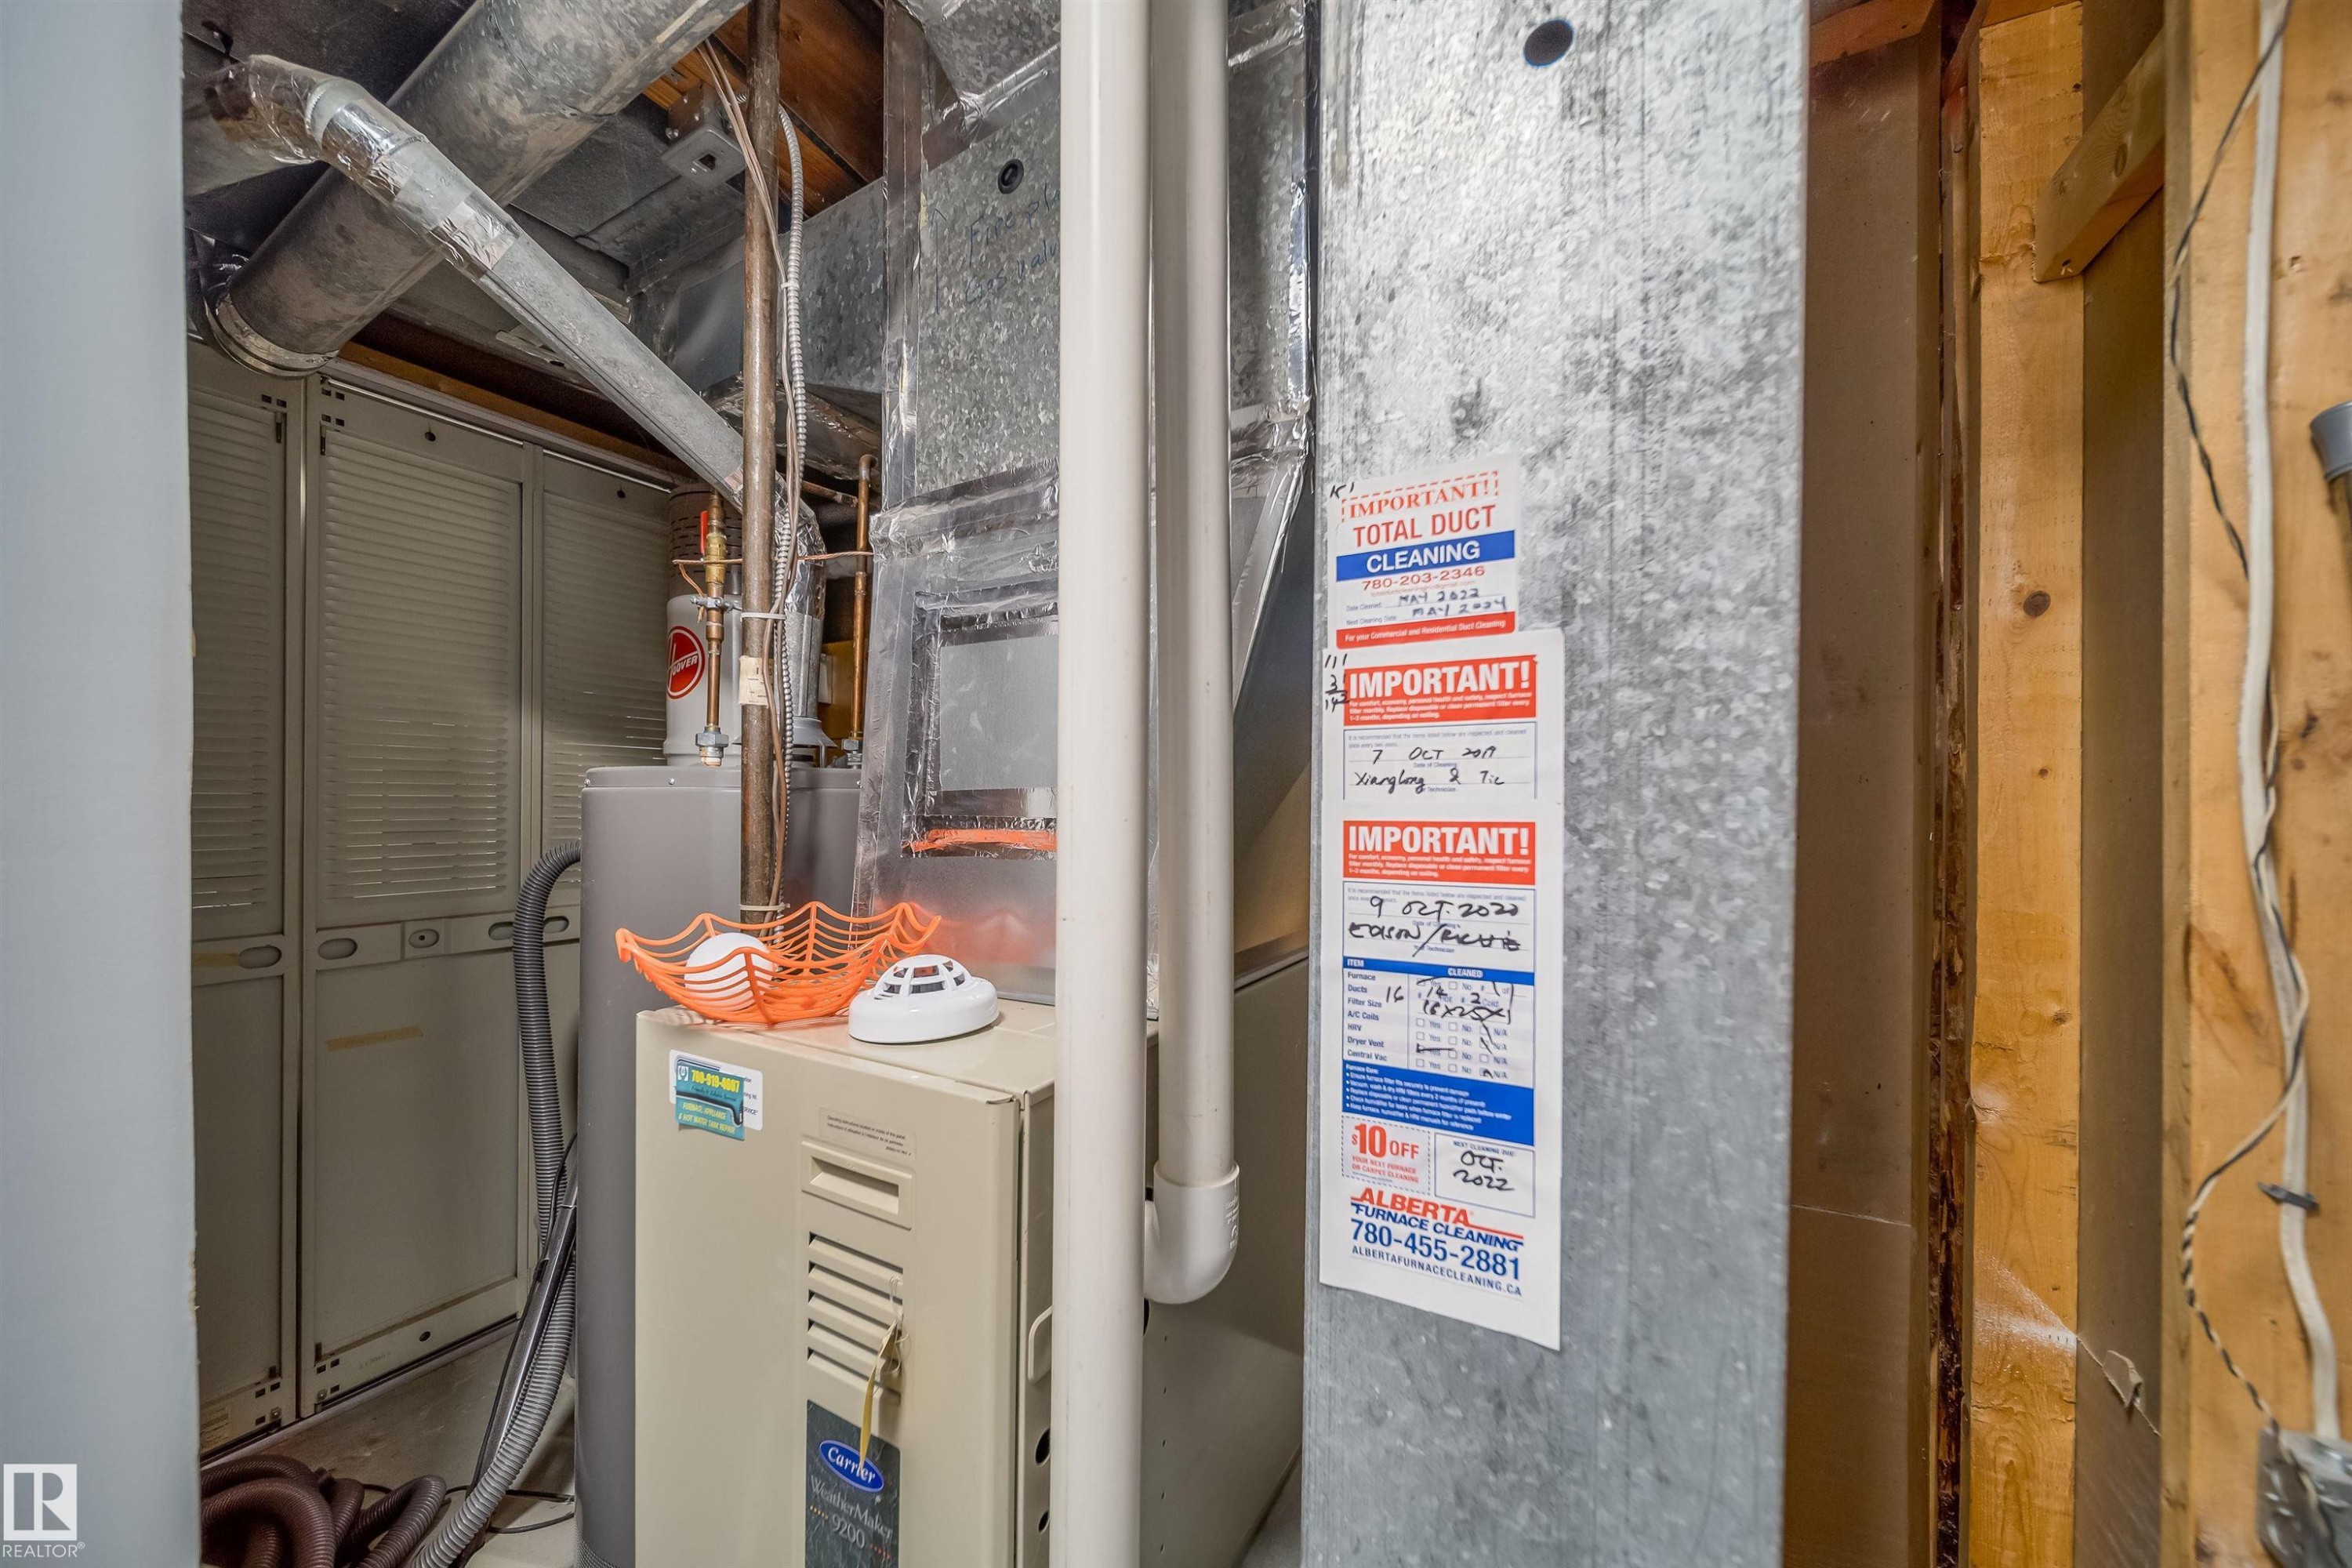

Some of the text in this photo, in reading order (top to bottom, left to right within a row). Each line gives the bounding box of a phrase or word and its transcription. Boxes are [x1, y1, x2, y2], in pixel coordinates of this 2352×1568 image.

[1353, 504, 1496, 548] TOTAL DUCT
[1367, 540, 1480, 573] CLEANING
[1362, 565, 1485, 591] 780-203-2346
[1399, 588, 1479, 607] MAY 2022
[1370, 630, 1407, 639] Commercial
[1421, 624, 1458, 634] Residential
[1458, 622, 1475, 631] Duct
[1349, 660, 1530, 699] IMPORTANT!
[1409, 746, 1443, 760] OCT
[1348, 826, 1529, 855] IMPORTANT!
[1370, 895, 1384, 918] 9
[1459, 902, 1519, 917] 2020
[1347, 958, 1483, 978] ITEM CLEANED
[1348, 971, 1376, 981] Furnace
[1462, 982, 1472, 991] No
[1348, 985, 1367, 993] Ducts
[1348, 997, 1382, 1007] Filter Size
[1348, 1010, 1360, 1018] A/C
[1362, 1012, 1380, 1021] Coils
[1462, 1024, 1472, 1033] No
[1348, 1023, 1362, 1032] HRV
[1429, 1034, 1441, 1043] Yes
[1462, 1038, 1472, 1047] No
[1348, 1036, 1366, 1046] Dryer
[1368, 1039, 1385, 1047] Vent
[1462, 1052, 1472, 1061] No
[1348, 1049, 1373, 1059] Central
[1374, 1053, 1388, 1062] Vac
[1429, 1062, 1441, 1070] Yes
[1462, 1065, 1472, 1074] No
[1352, 1123, 1420, 1160] $10 OFF
[1469, 1143, 1499, 1155] CLEANING
[1352, 1155, 1417, 1174] YOUR NEXT FURNACE
[1362, 1166, 1385, 1177] CARPET
[1386, 1170, 1420, 1184] CLEANING
[1453, 1169, 1515, 1191] 2022
[1351, 1187, 1472, 1226] ALBERTA
[1351, 1202, 1524, 1252] FURNACE CLEANING
[1351, 1218, 1519, 1281] 780-455-2881
[1352, 1245, 1523, 1297] ALBERTAFURNACECLEANING.CA
[827, 1446, 876, 1483] Carrier
[809, 1474, 893, 1540] WeatherMaker
[831, 1513, 866, 1550] 9200
